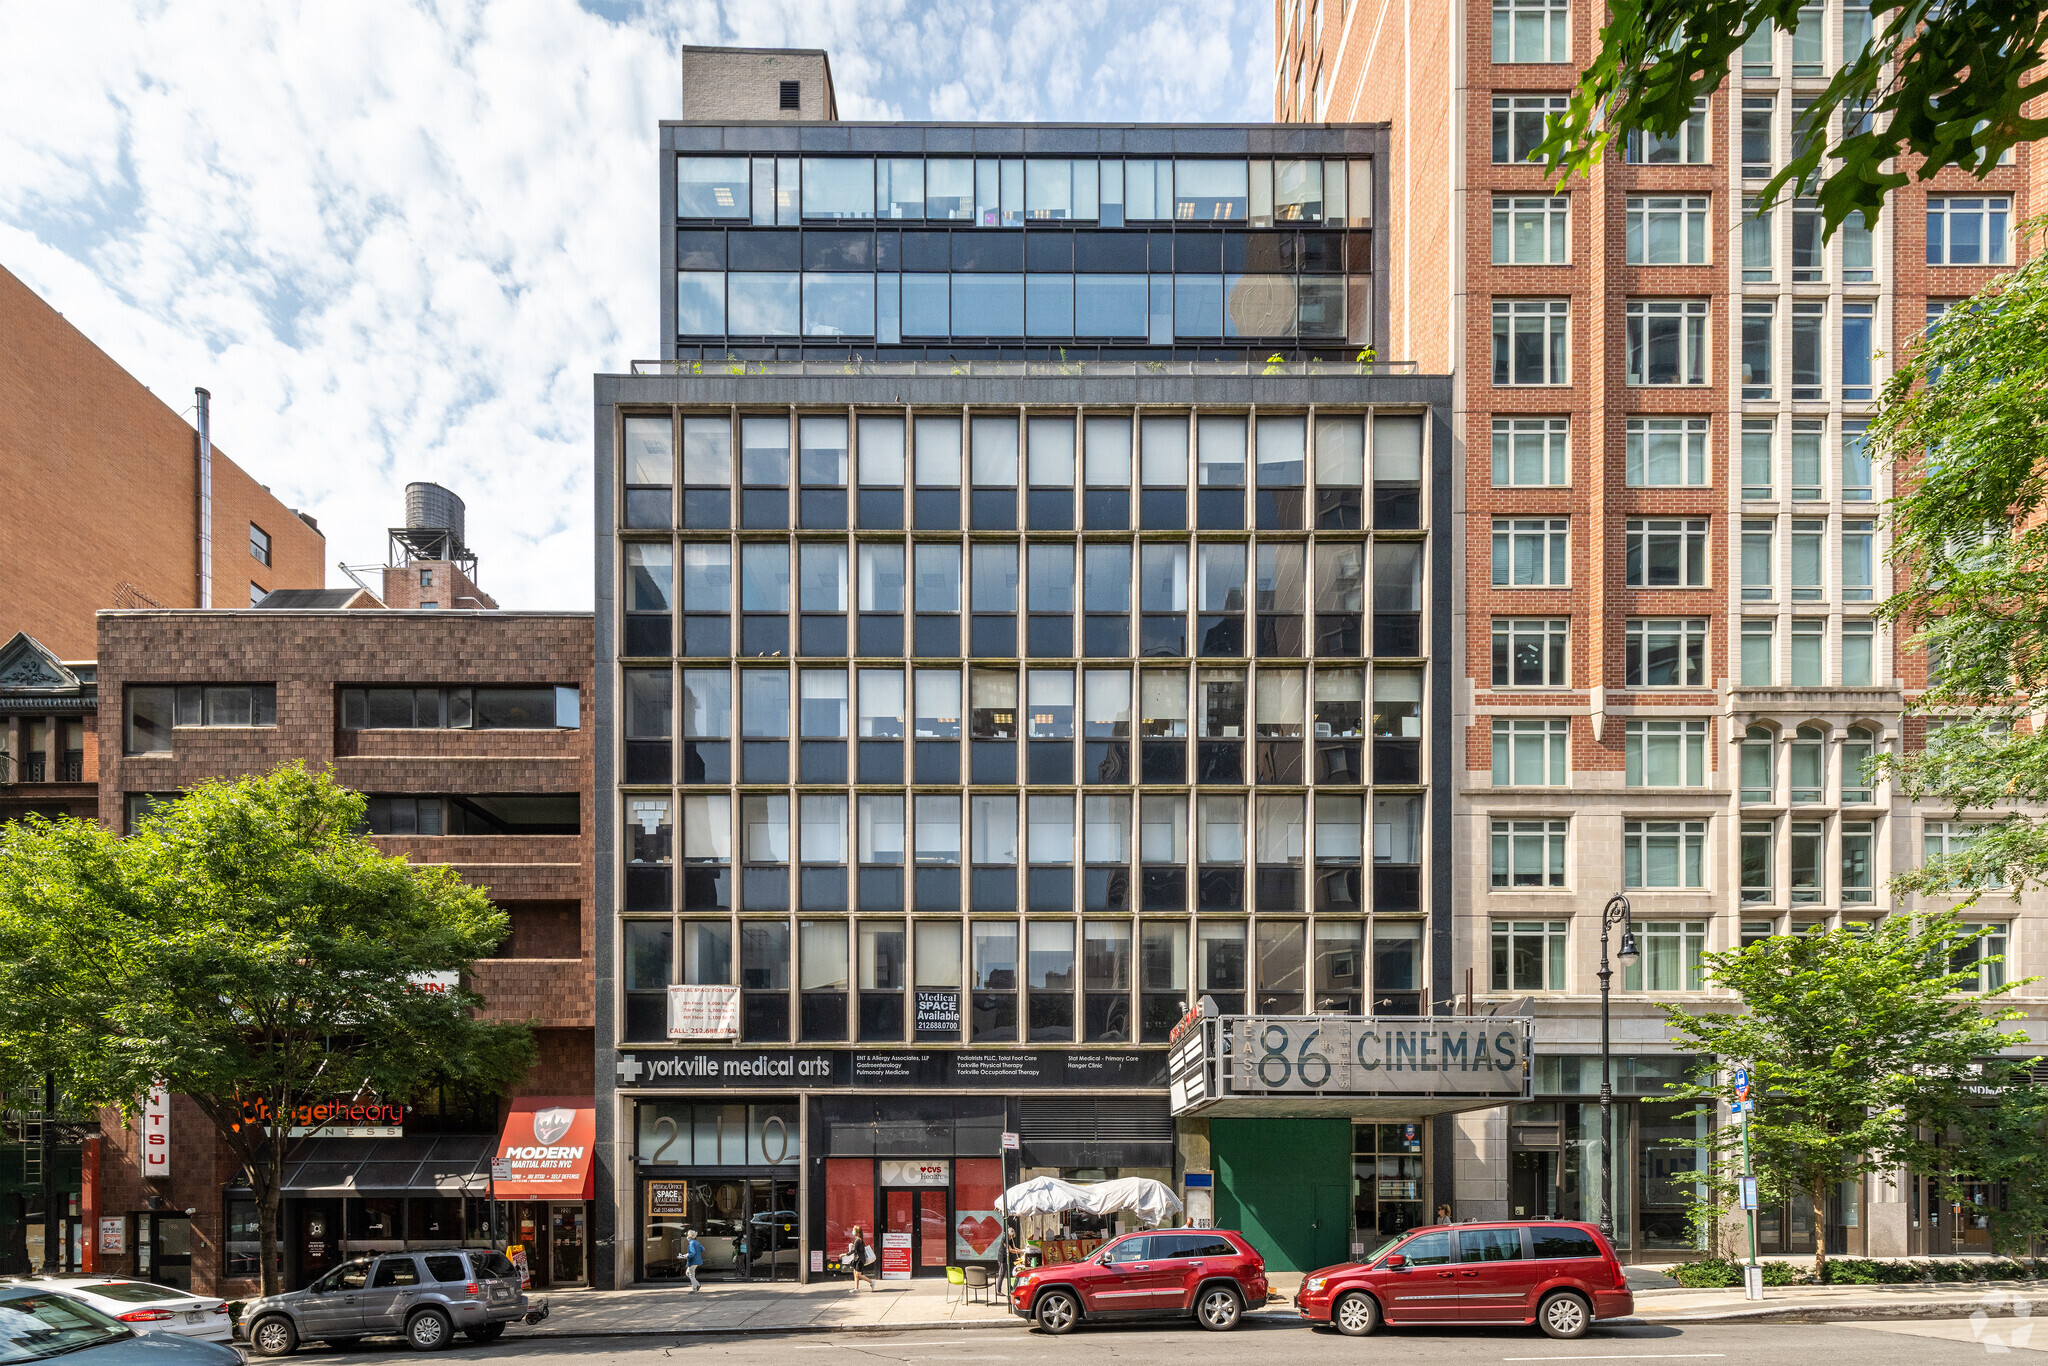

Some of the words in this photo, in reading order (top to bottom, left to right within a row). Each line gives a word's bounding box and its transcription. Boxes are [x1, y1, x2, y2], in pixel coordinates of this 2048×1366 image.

[918, 993, 957, 1001] Medical
[919, 1002, 957, 1010] SPACE
[917, 1010, 960, 1020] Available
[1243, 1024, 1253, 1089] EAST
[1338, 1025, 1349, 1090] STREET
[1357, 1031, 1516, 1072] CINEMAS
[647, 1056, 719, 1081] yorkville
[723, 1055, 794, 1076] medical
[798, 1056, 830, 1076] arts
[237, 1097, 403, 1126] rgetheory
[652, 1115, 788, 1166] 210
[505, 1146, 584, 1159] MODERN
[511, 1160, 539, 1168] MARTIAL
[540, 1160, 557, 1168] ARTS
[558, 1160, 573, 1168] NYC
[657, 1190, 678, 1198] SPACE
